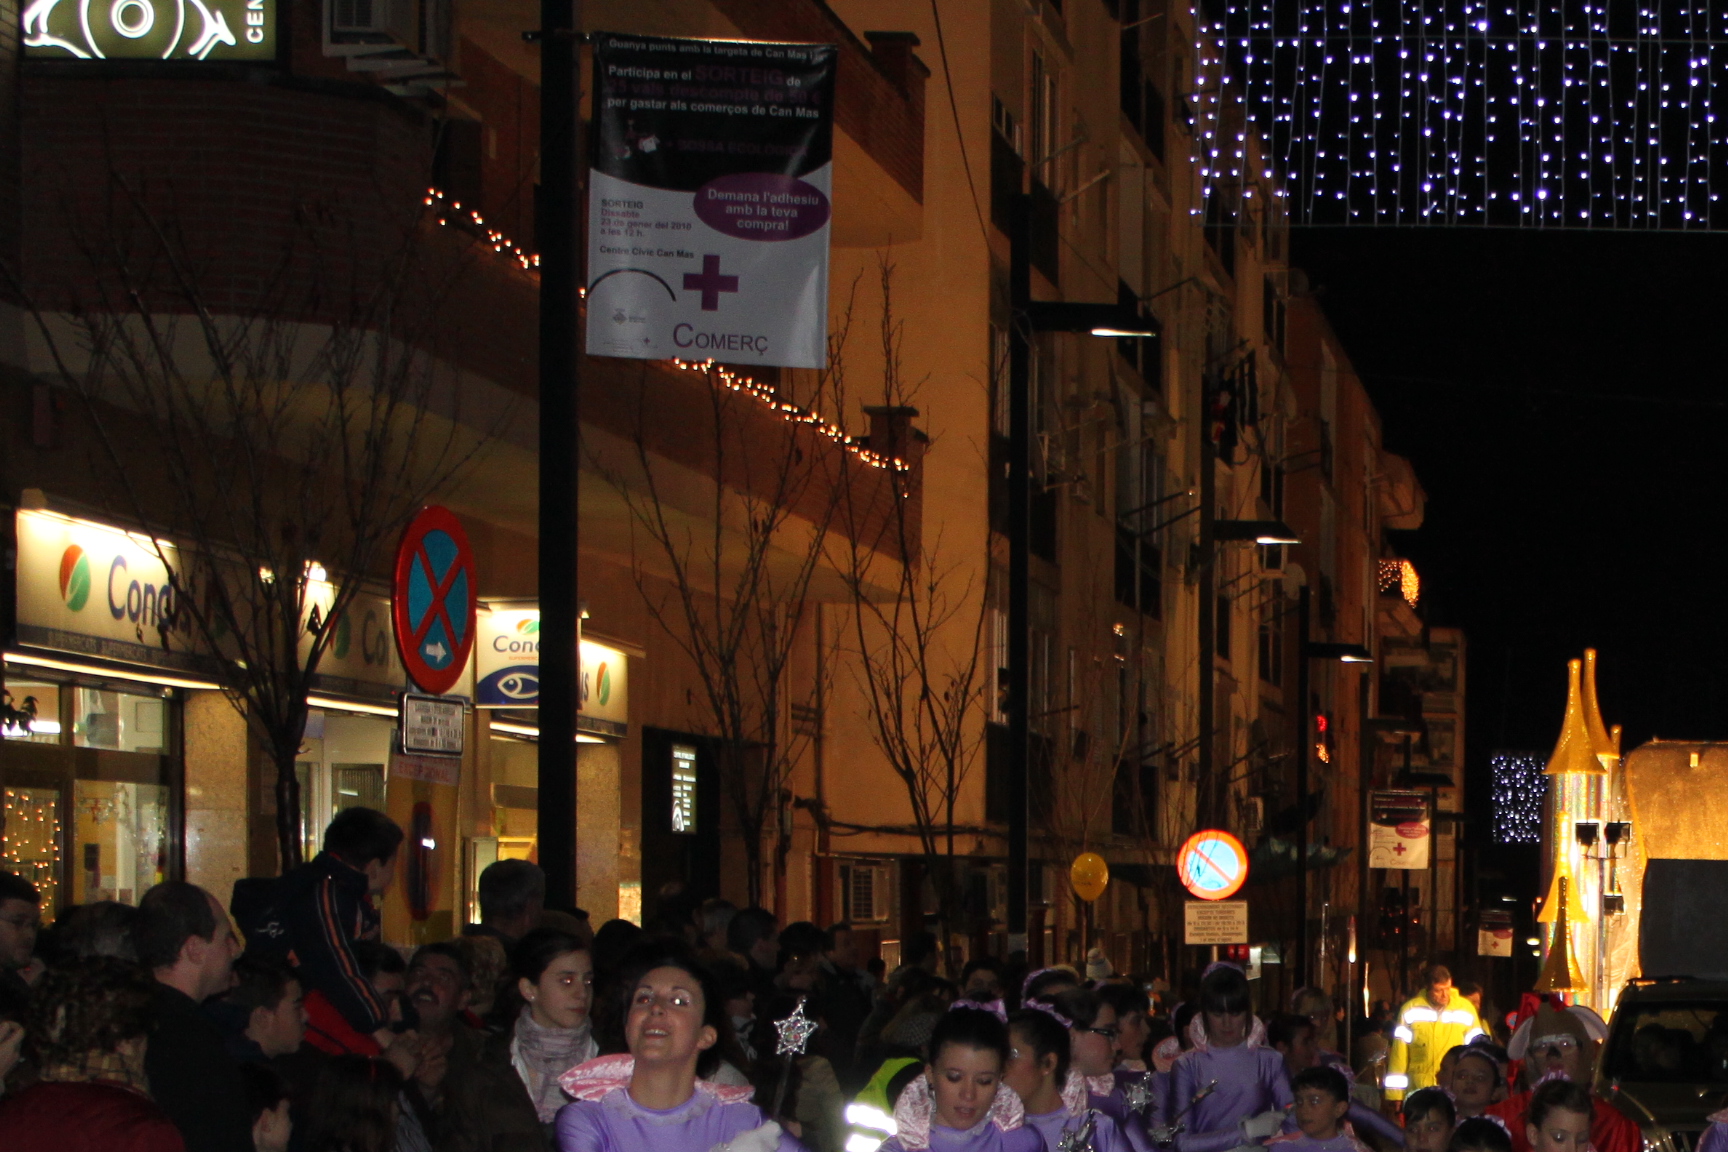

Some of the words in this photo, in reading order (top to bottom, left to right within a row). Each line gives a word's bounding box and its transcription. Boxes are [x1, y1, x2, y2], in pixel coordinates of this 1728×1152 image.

[609, 38, 646, 51] Guanya
[649, 43, 677, 53] punts
[679, 45, 700, 53] amb
[703, 45, 712, 54] la
[714, 46, 748, 57] targeta
[750, 48, 762, 57] de
[765, 48, 785, 58] Can
[787, 49, 807, 60] Mas
[608, 65, 660, 80] Participa
[663, 70, 679, 80] en
[681, 69, 692, 81] el
[695, 64, 784, 86] SORTEIG
[786, 76, 801, 87] de
[607, 98, 627, 109] per
[630, 99, 667, 111] gastar
[670, 100, 687, 111] als
[690, 102, 749, 116] comerços
[751, 104, 766, 116] de
[769, 105, 793, 117] Can
[795, 106, 820, 118] Mas
[601, 199, 644, 209] SORTEIG
[707, 188, 760, 203] Demana
[763, 191, 819, 206] l'adhesiu
[725, 204, 753, 215] amb
[756, 206, 768, 217] la
[771, 207, 798, 218] teva
[736, 218, 789, 231] compra!
[600, 245, 629, 256] Centre
[657, 249, 674, 258] Can
[676, 250, 695, 259] Mas
